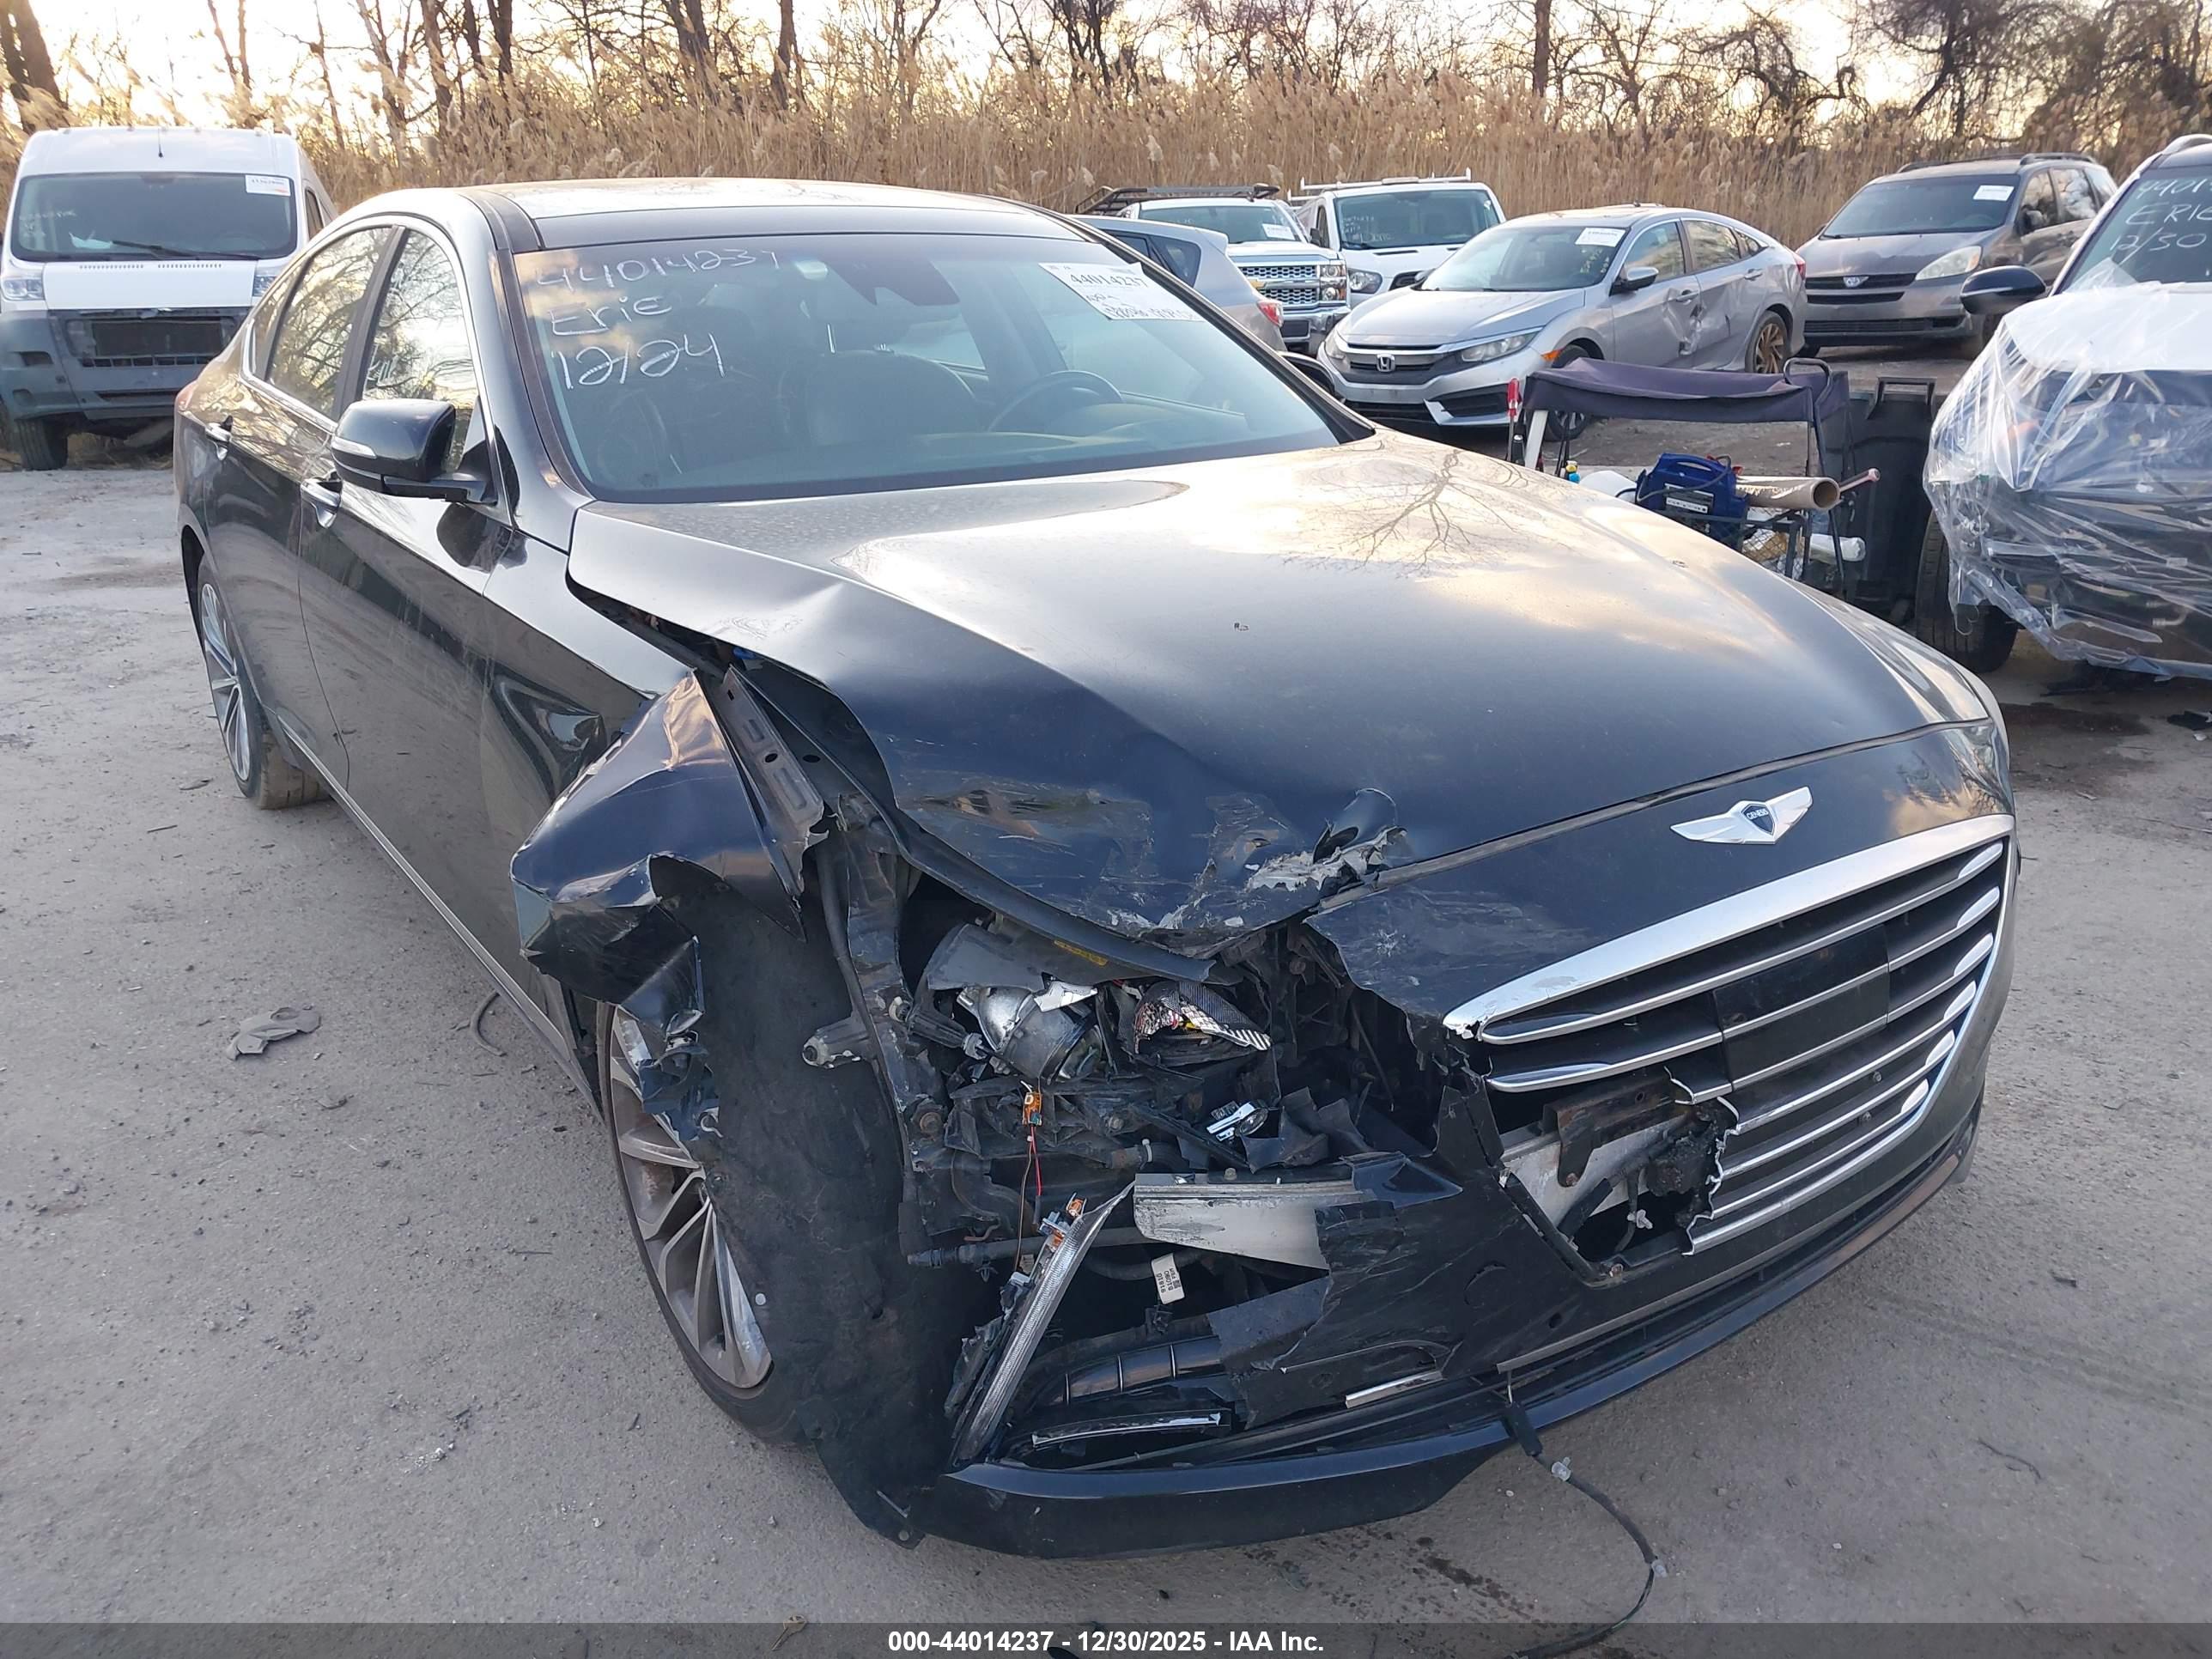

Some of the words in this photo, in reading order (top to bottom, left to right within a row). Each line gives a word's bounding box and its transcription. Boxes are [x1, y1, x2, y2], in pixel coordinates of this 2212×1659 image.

[536, 248, 780, 293] 44014237
[1069, 273, 1149, 288] 44014237
[550, 332, 726, 390] 12/24
[1746, 808, 1769, 820] GENESIS
